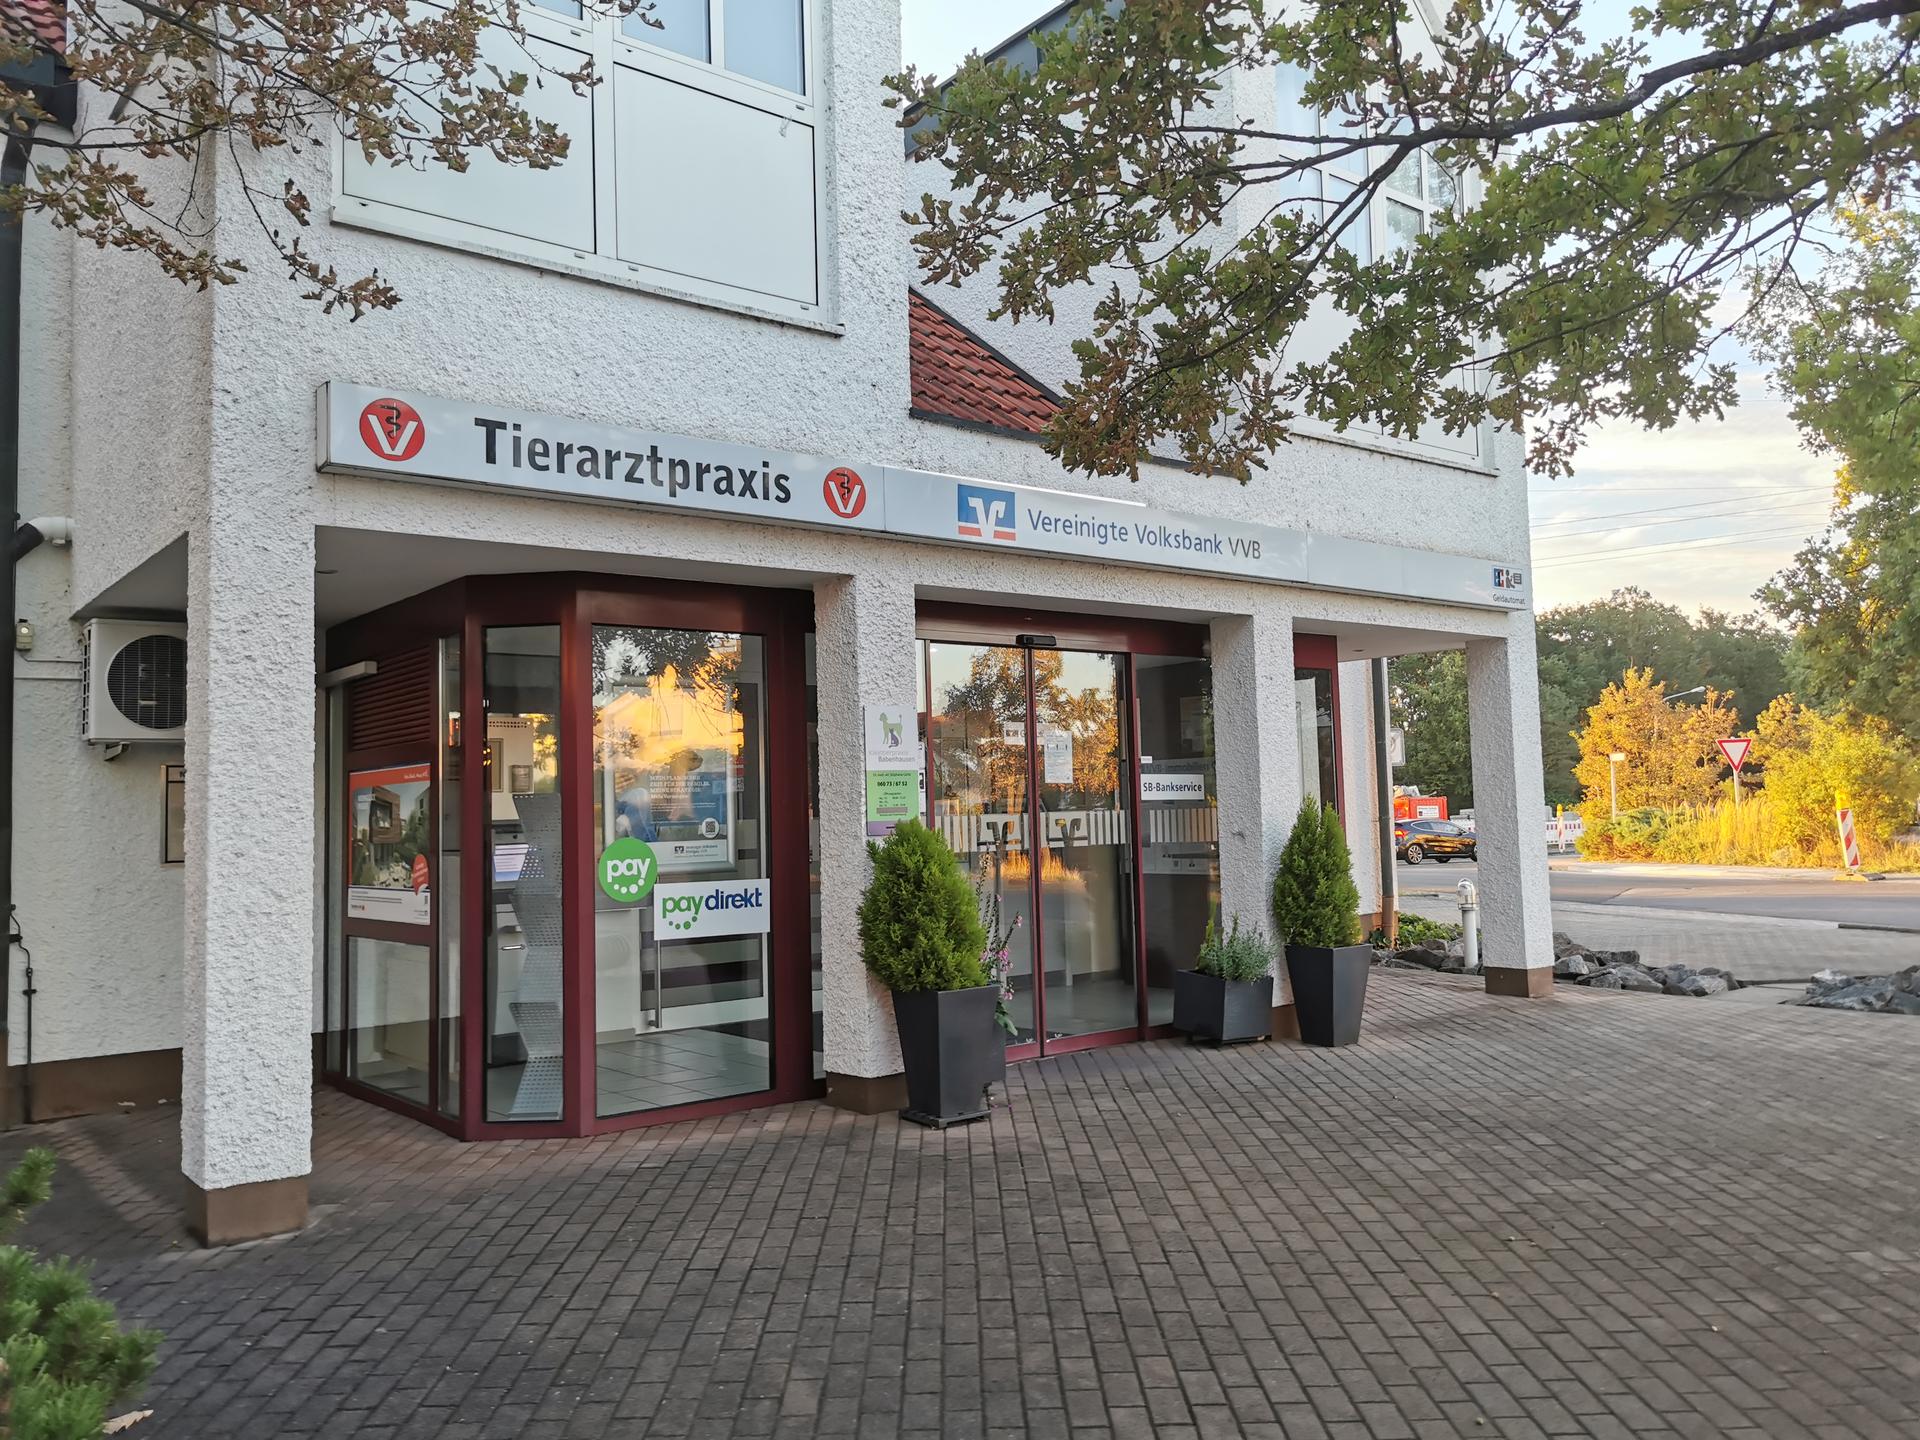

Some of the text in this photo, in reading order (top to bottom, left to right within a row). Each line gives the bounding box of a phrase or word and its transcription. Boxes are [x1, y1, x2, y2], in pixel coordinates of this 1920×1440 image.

[474, 417, 791, 504] Tierarztpraxis
[1027, 509, 1261, 560] Vereinigte Volksbank VVB
[1143, 781, 1202, 792] SB-Bankservice
[607, 858, 651, 882] pay
